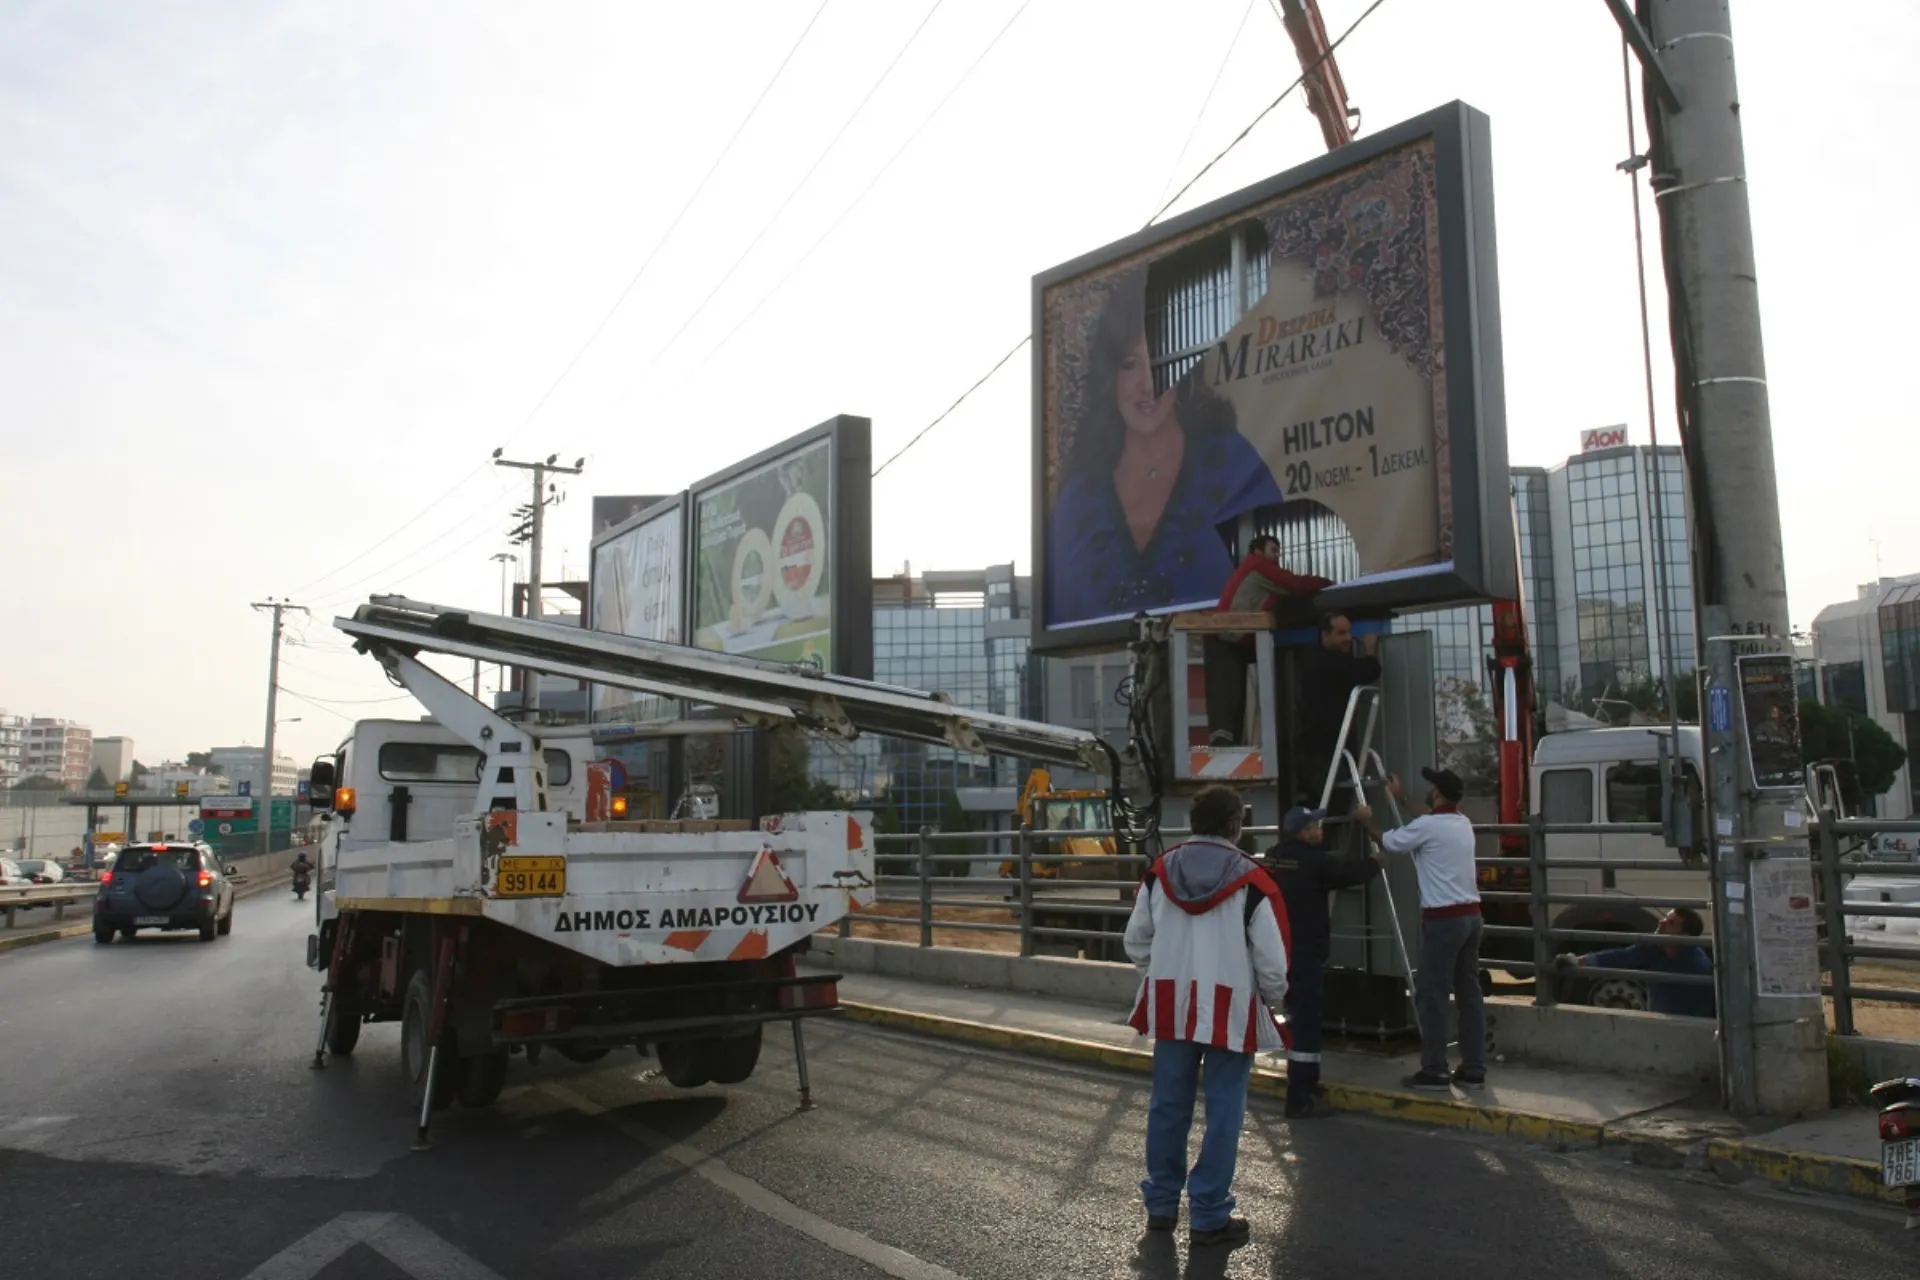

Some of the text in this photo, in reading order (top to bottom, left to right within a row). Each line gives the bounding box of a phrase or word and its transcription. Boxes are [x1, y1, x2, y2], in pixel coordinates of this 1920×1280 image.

[1213, 315, 1366, 387] MIRARAKI
[1283, 405, 1375, 456] HILTON
[1285, 460, 1312, 495] 20
[1368, 444, 1378, 478] 1
[505, 873, 557, 892] 99144
[554, 903, 819, 932] ΔΗΜΟΣ ΑΜΑΡΟΥΣΙΟΥ
[1886, 1161, 1913, 1185] 786
